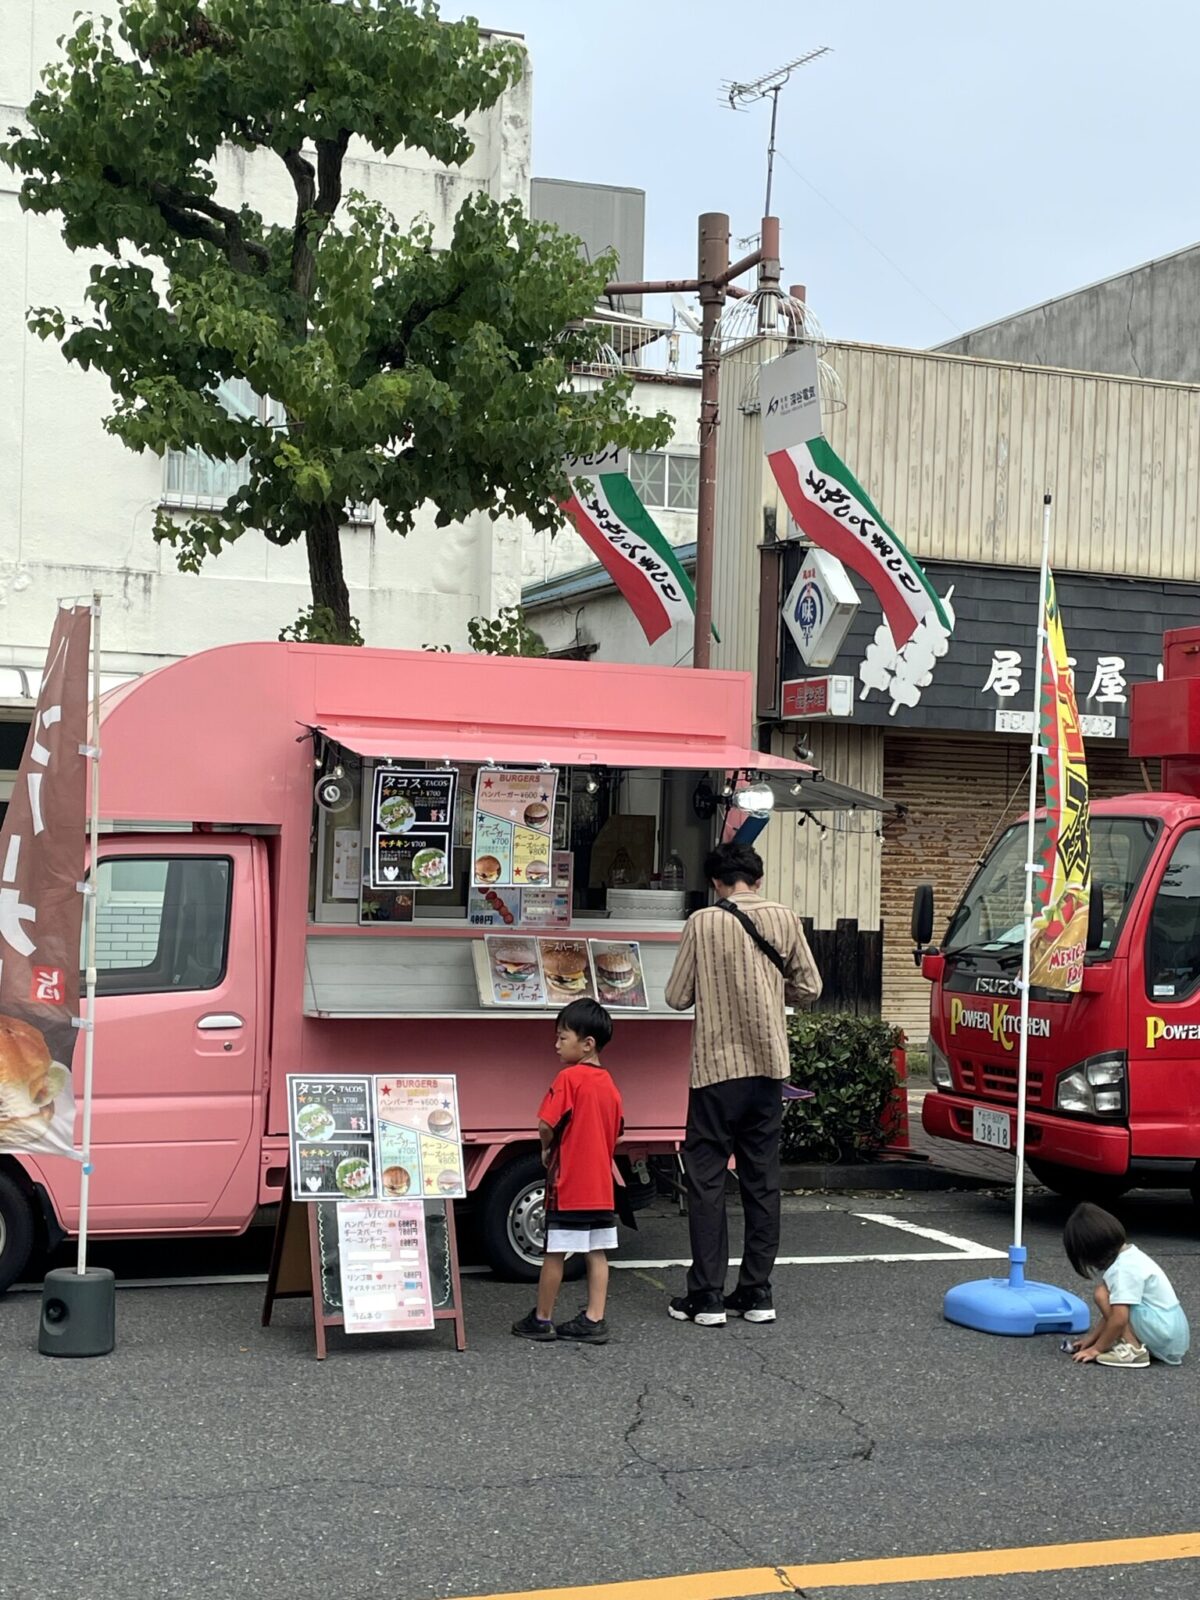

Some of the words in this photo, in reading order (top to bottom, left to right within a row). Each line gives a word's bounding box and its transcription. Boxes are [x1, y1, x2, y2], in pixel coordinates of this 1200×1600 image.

[981, 650, 1127, 703] 居屋
[384, 776, 421, 789] タコス
[499, 774, 541, 783] BURGERS
[481, 791, 520, 799] ハンバーガー
[520, 791, 538, 799] ¥600
[388, 839, 411, 848] チキン
[975, 977, 1019, 996] ISUZU
[950, 997, 994, 1035] POWER
[1145, 1016, 1200, 1048] POWE
[298, 1083, 337, 1096] タコス
[396, 1079, 439, 1088] BURGERS
[380, 1098, 420, 1106] ハンバーガー
[364, 1206, 401, 1219] Menu
